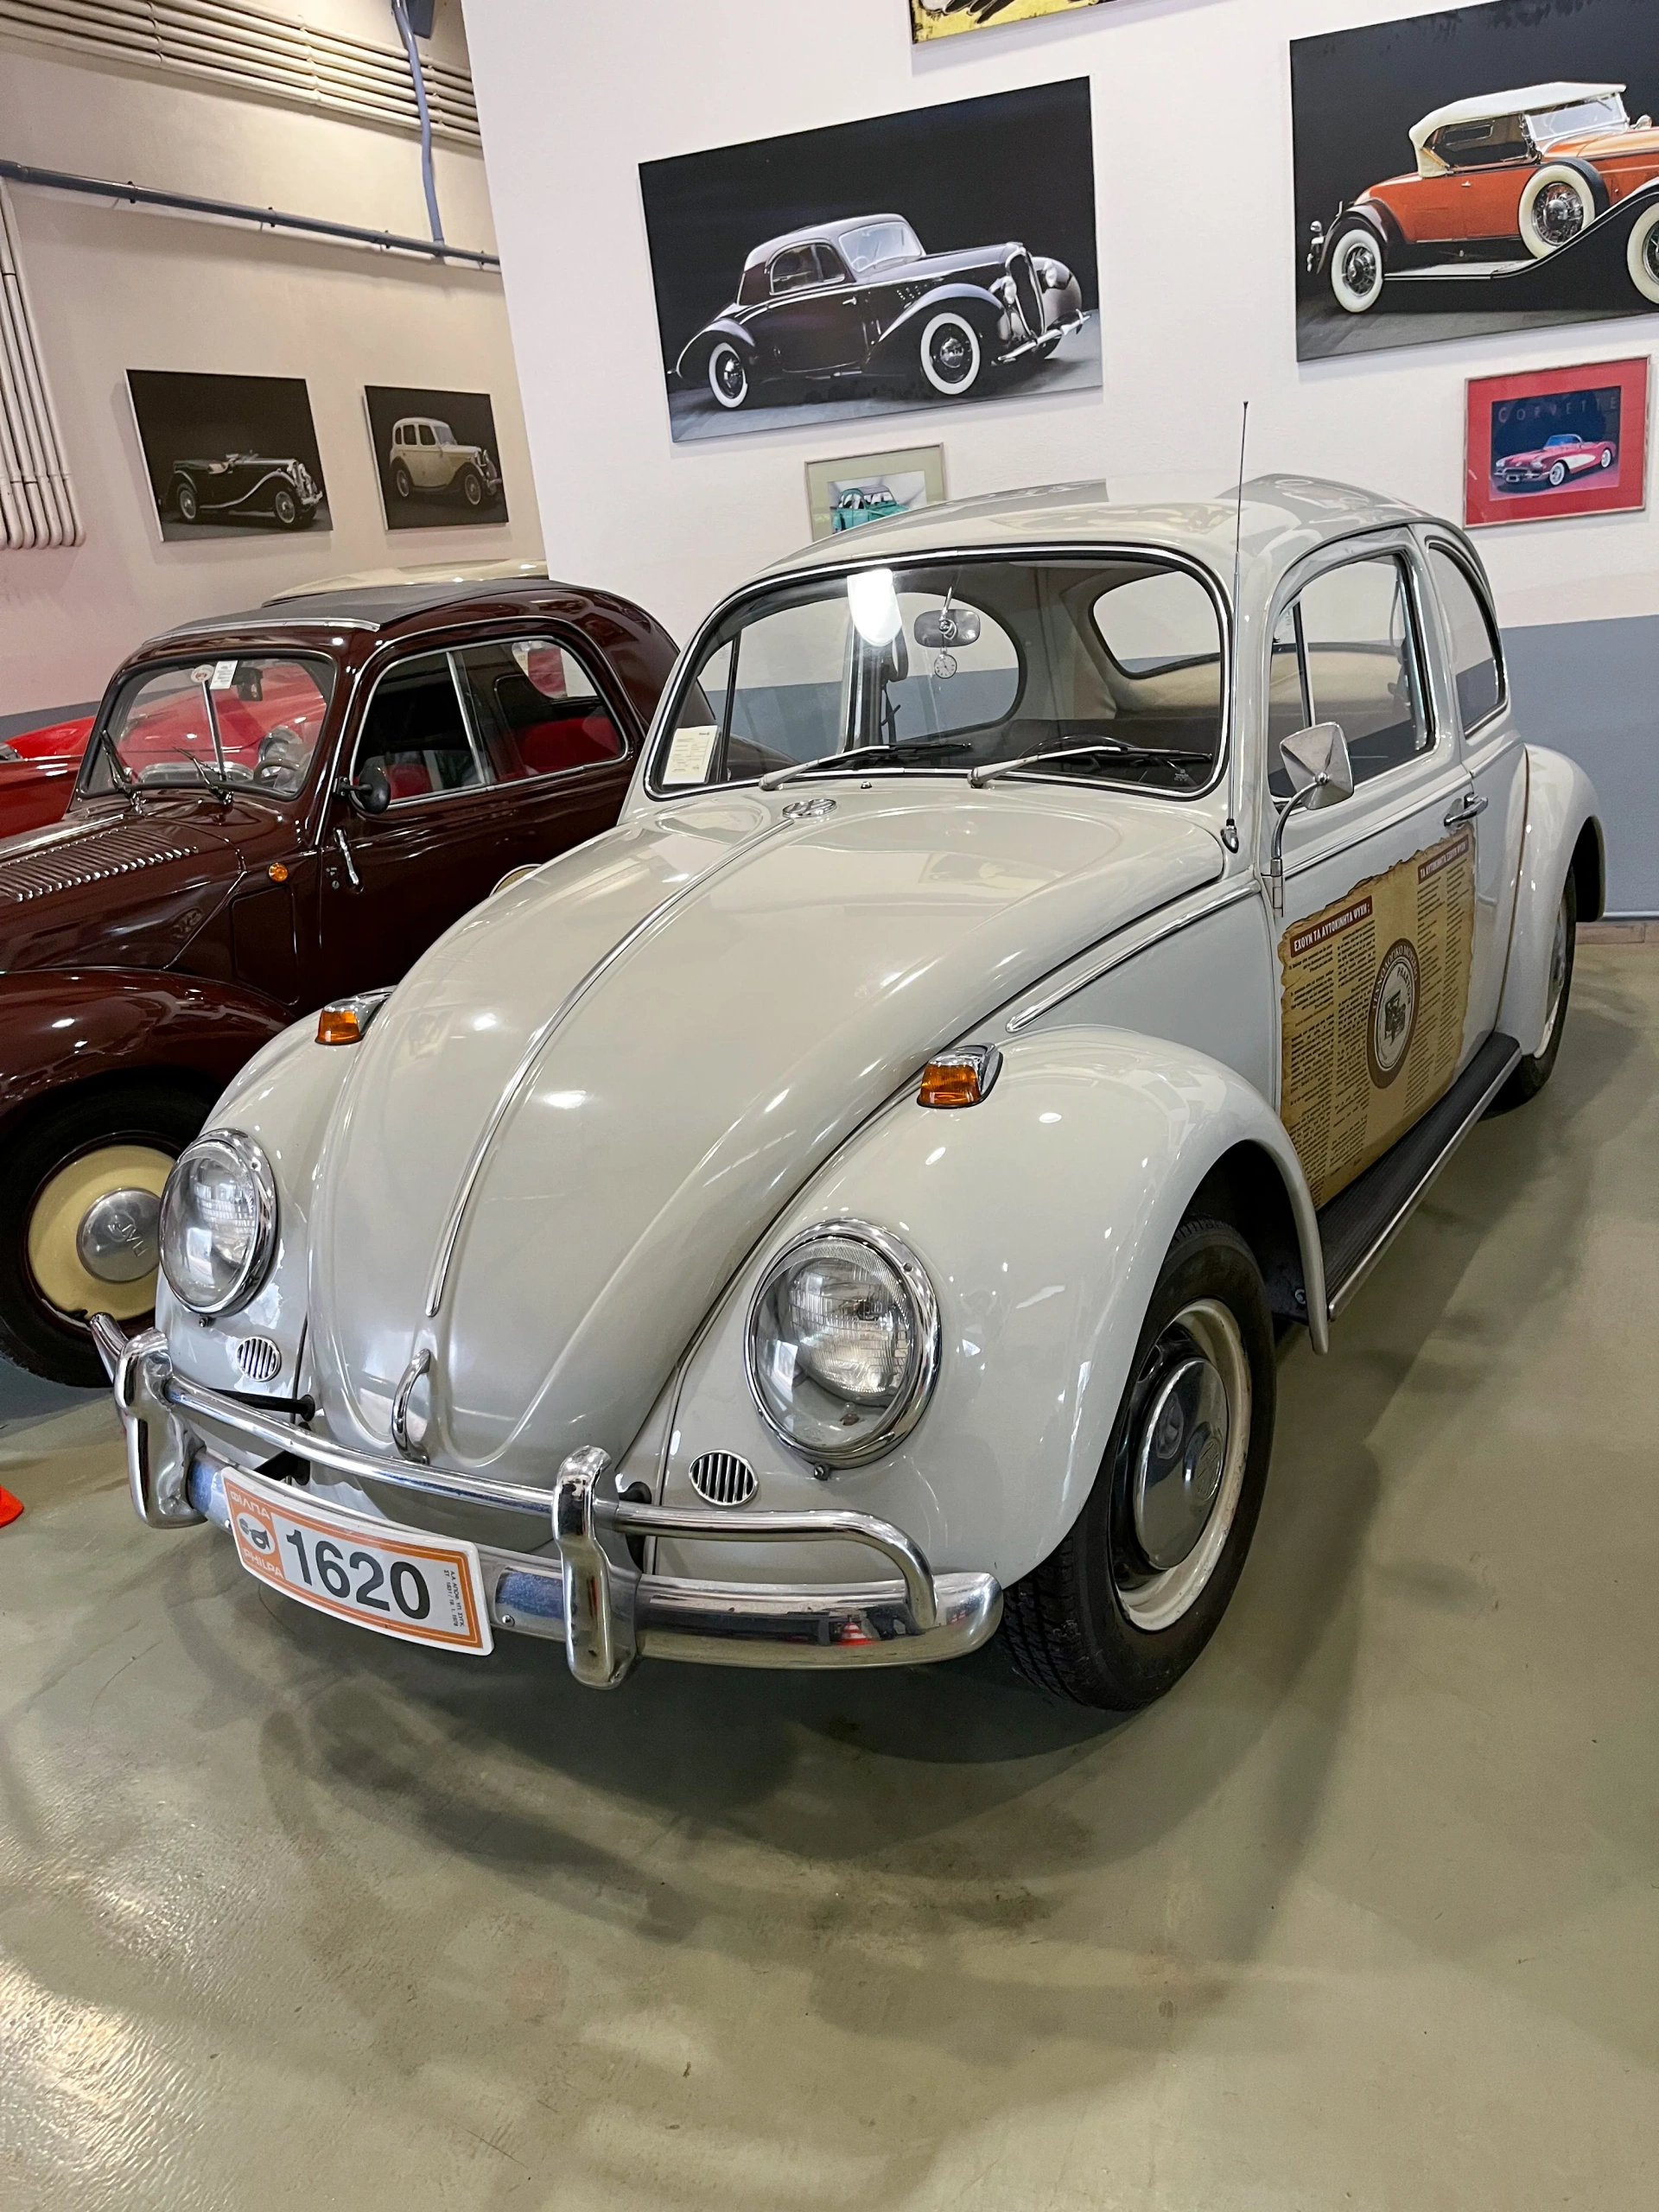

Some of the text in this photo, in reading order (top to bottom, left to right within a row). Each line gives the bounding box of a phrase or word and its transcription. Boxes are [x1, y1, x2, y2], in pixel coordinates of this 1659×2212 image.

[230, 1491, 270, 1521] ΦΙΛΠΑ
[242, 1548, 285, 1580] PHILPA
[286, 1529, 430, 1620] 1620
